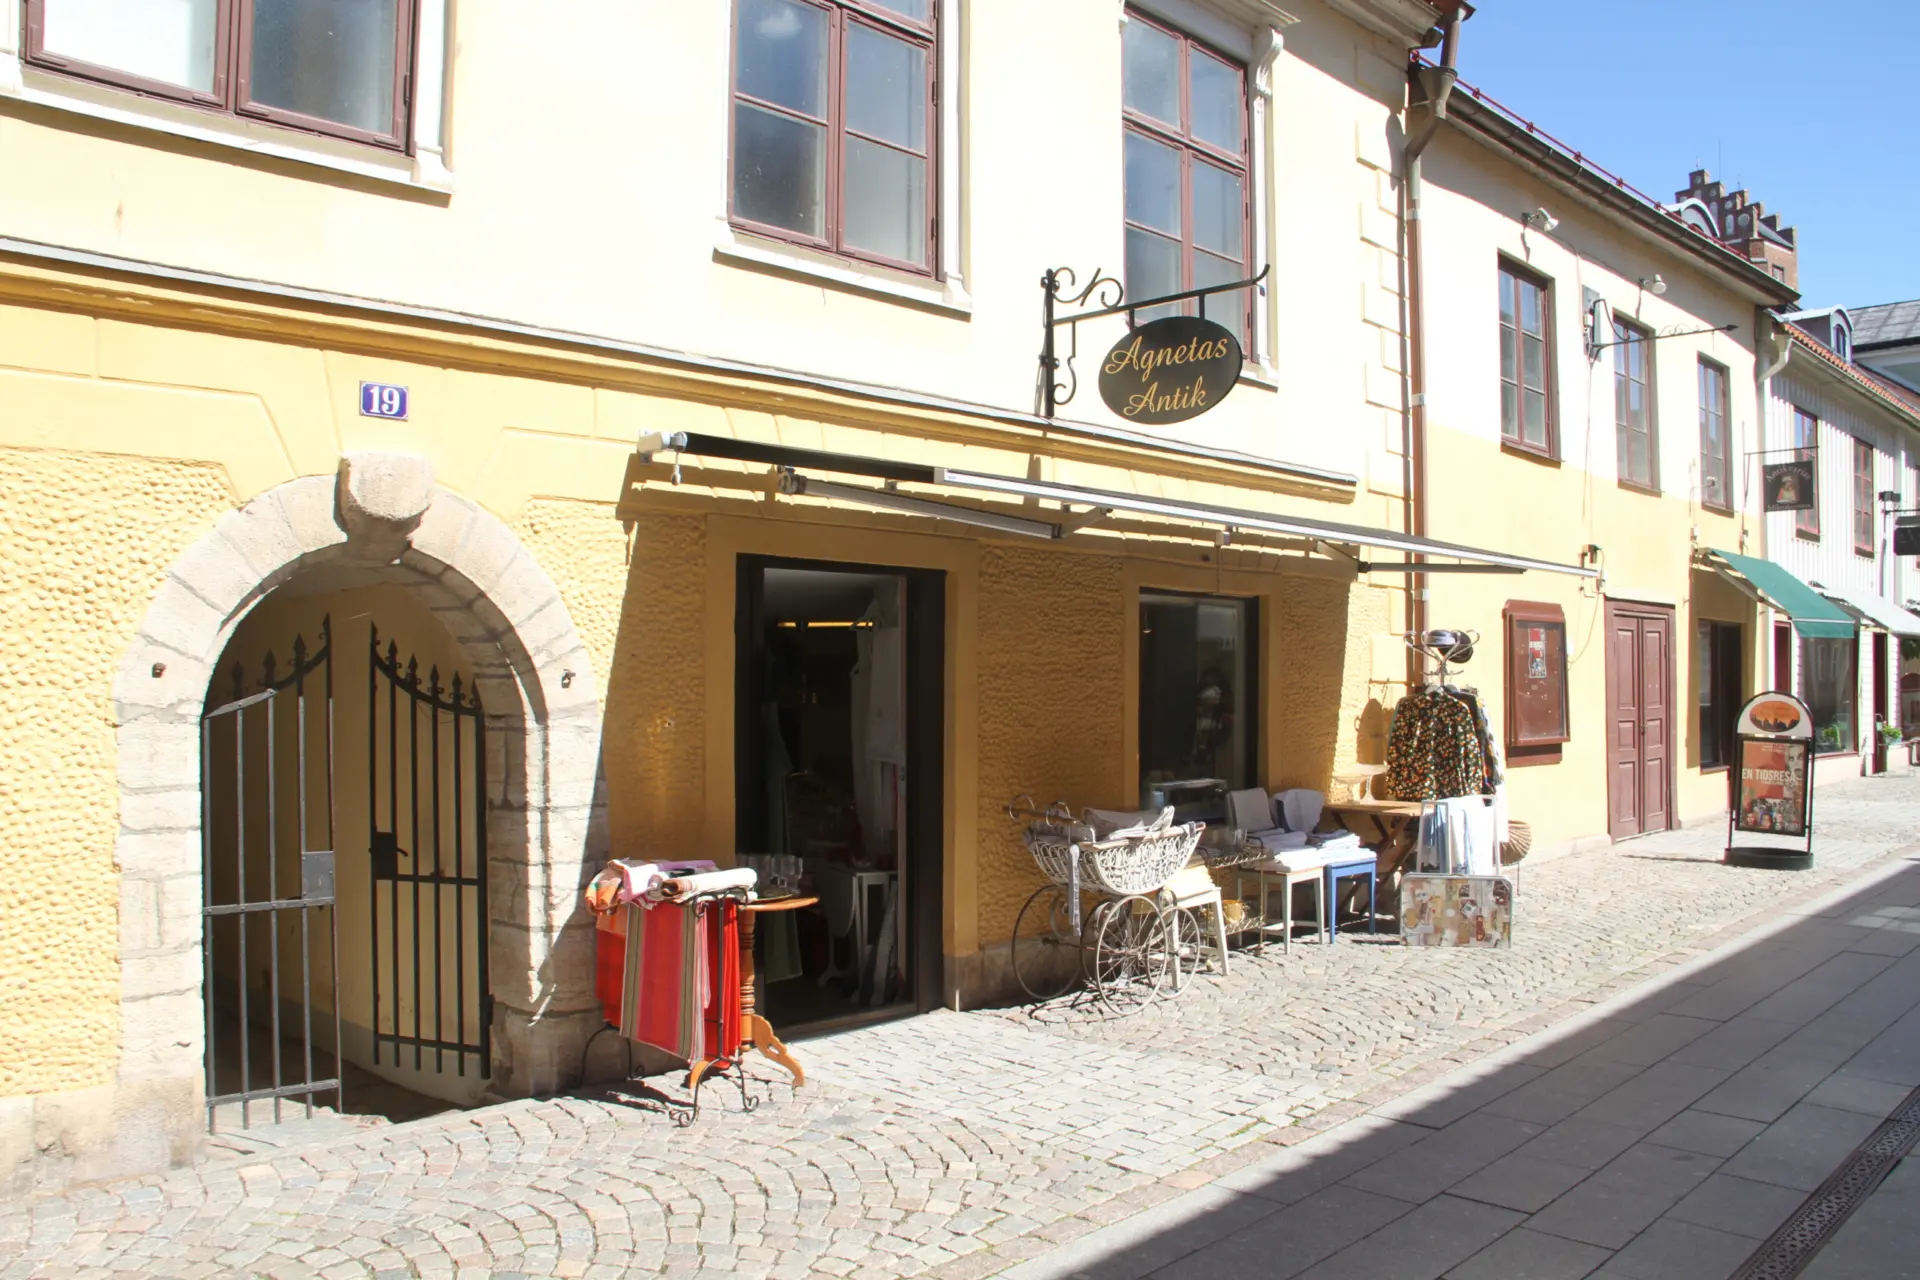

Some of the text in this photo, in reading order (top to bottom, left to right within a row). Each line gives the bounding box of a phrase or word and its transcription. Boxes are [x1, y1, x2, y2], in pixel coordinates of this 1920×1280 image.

[1105, 336, 1229, 383] Agnetas
[369, 386, 400, 415] 19
[1123, 376, 1207, 416] Antik
[1742, 768, 1753, 780] EN
[1755, 769, 1797, 783] TIDSRESA
